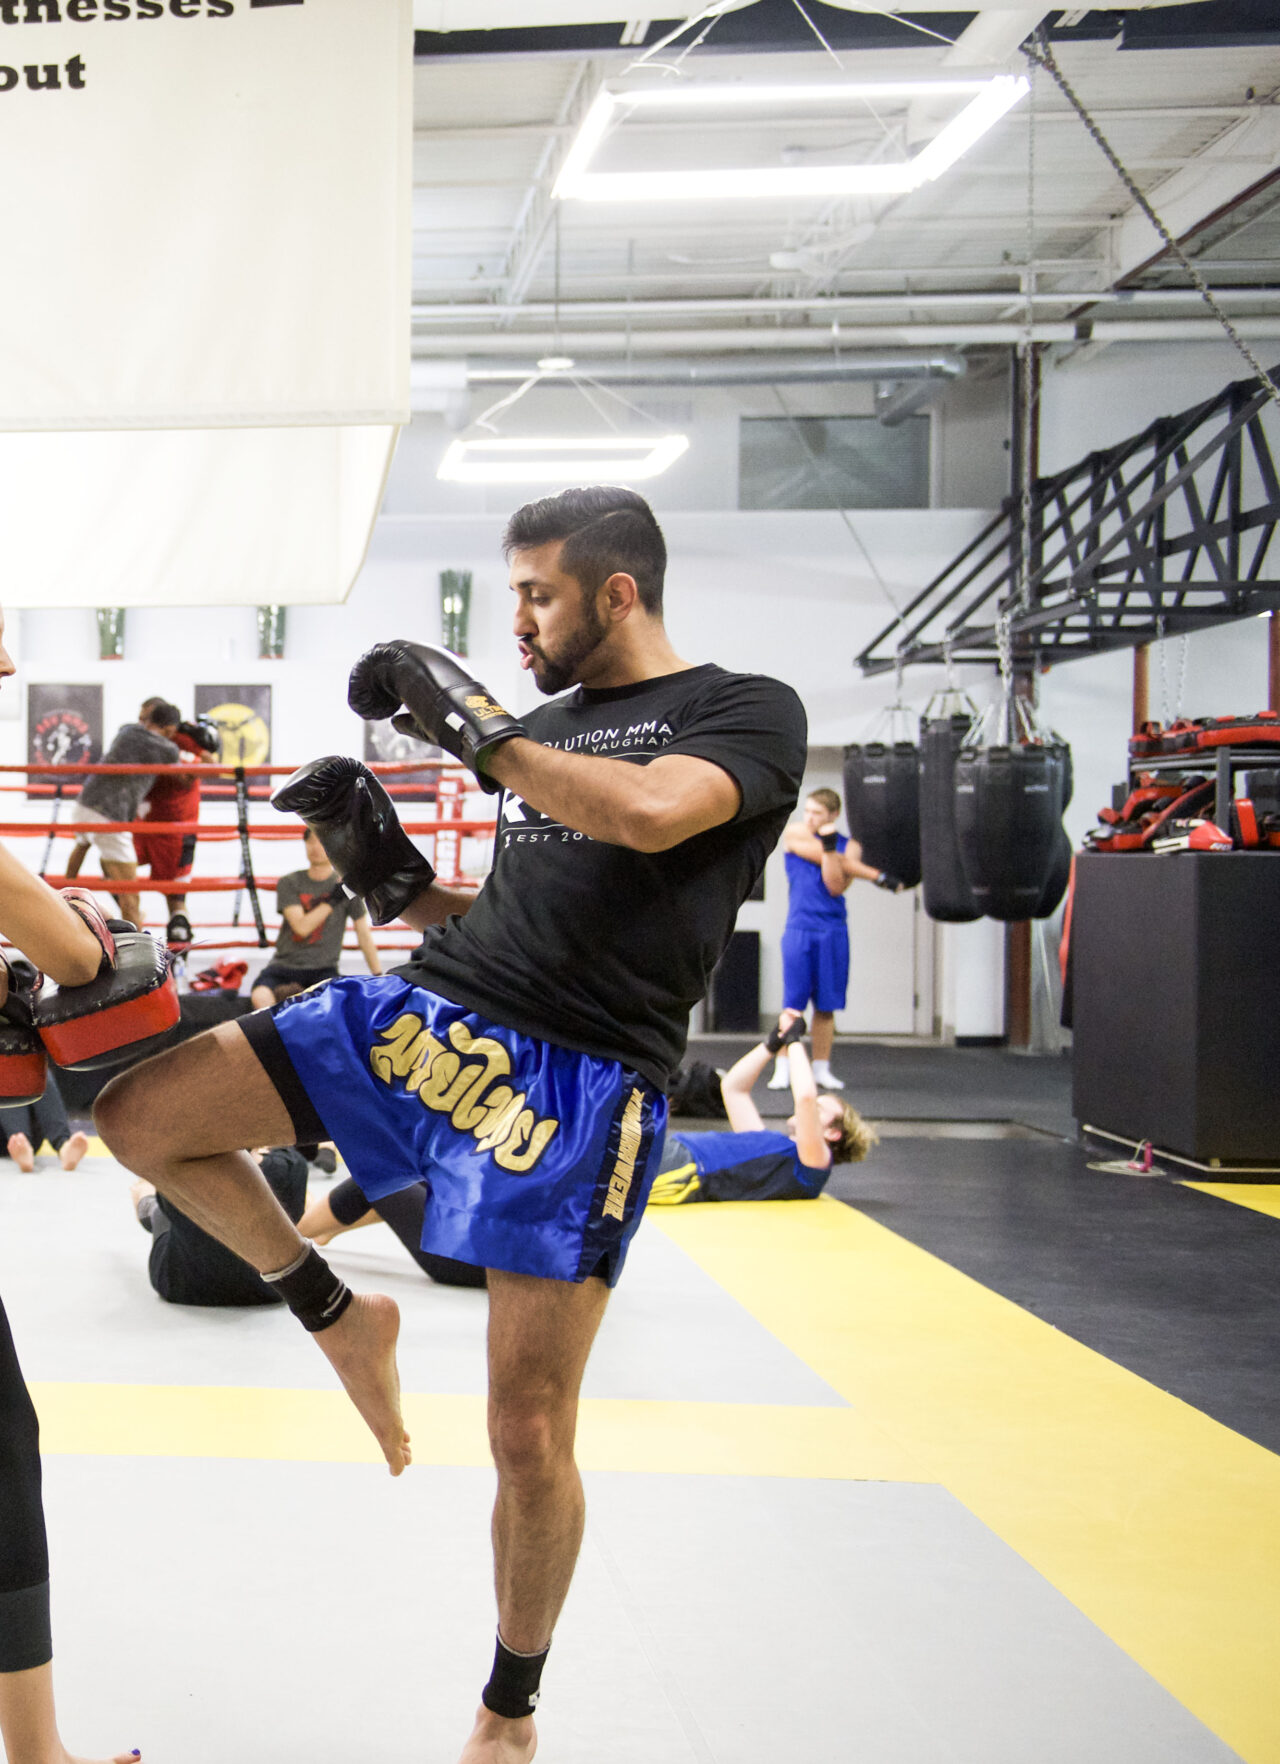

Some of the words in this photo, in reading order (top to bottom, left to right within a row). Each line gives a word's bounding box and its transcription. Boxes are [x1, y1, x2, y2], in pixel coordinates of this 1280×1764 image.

[625, 720, 673, 736] MMA
[591, 736, 672, 753] VAUGHAN
[516, 834, 551, 843] EST
